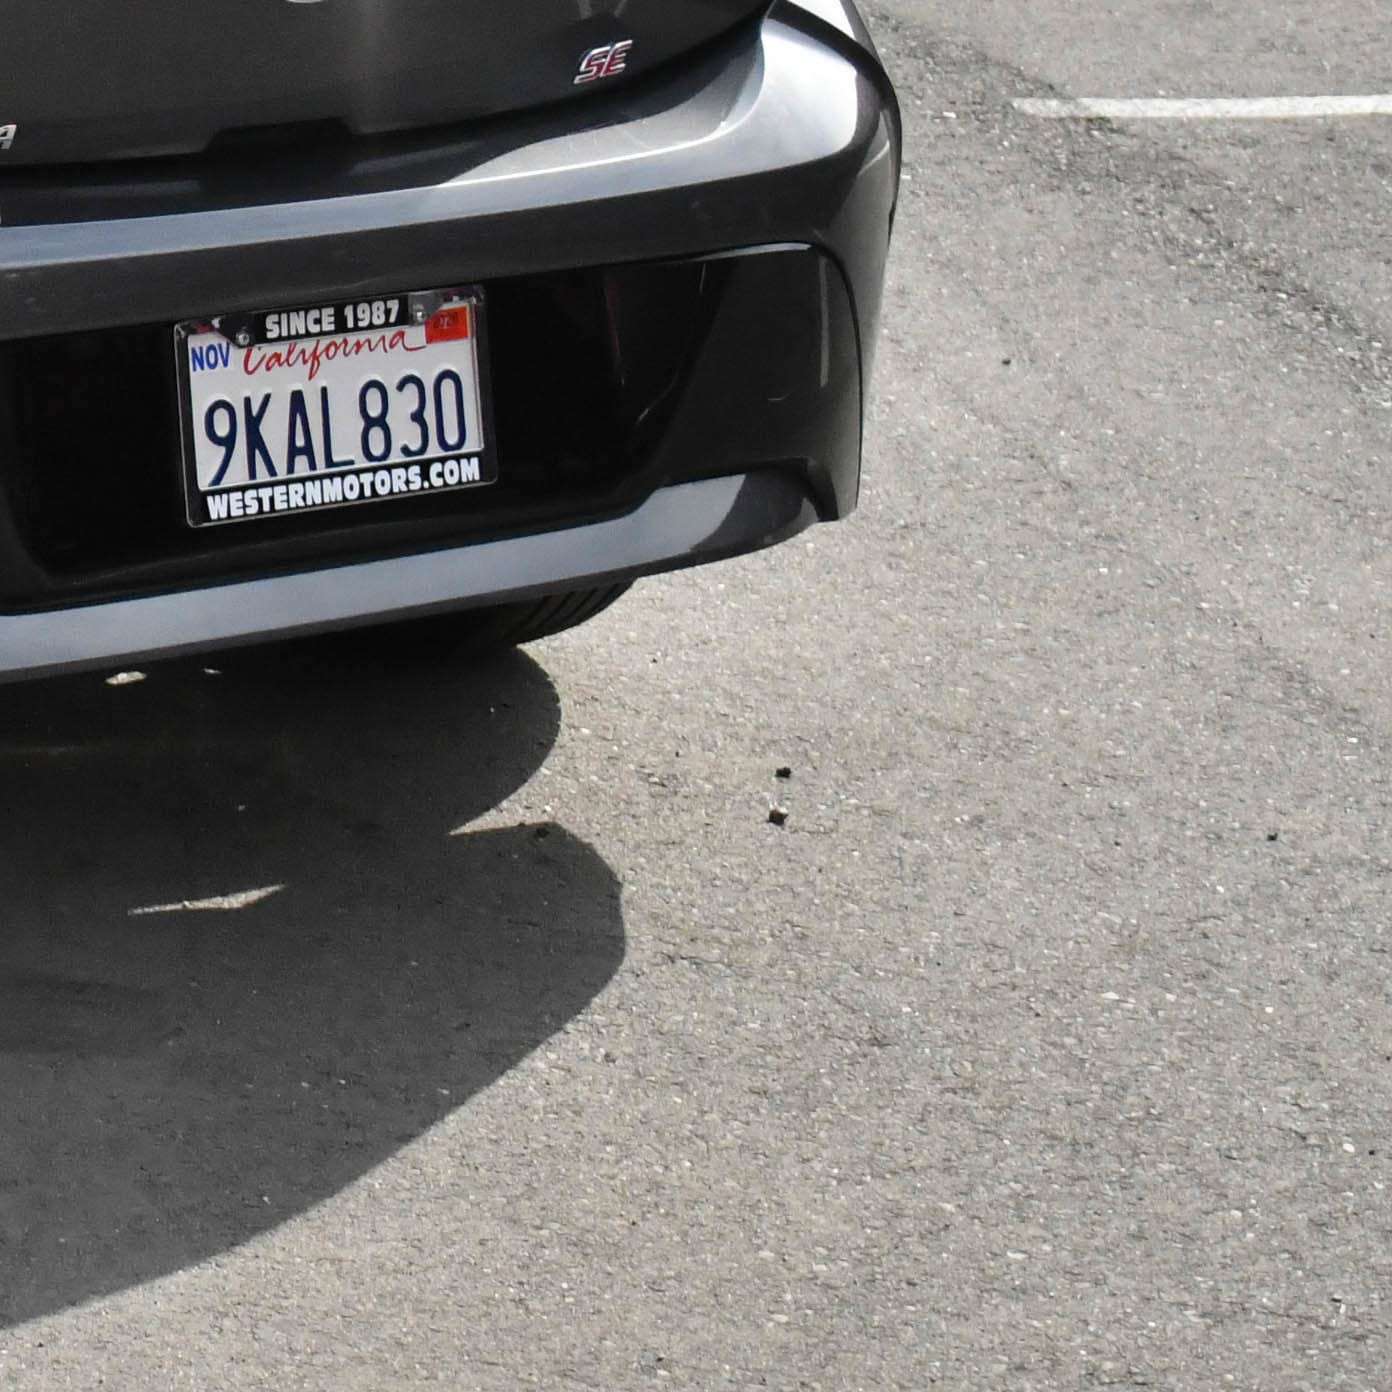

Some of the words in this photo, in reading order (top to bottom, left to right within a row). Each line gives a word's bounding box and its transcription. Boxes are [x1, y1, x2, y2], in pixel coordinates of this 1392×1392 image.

[573, 39, 634, 84] SE
[266, 306, 335, 339] SINCE
[344, 299, 400, 329] 1987
[191, 342, 232, 372] NOV
[242, 329, 426, 380] California
[204, 368, 467, 487] 9KAL830
[207, 456, 480, 521] WESTERNMOTORS.COM
